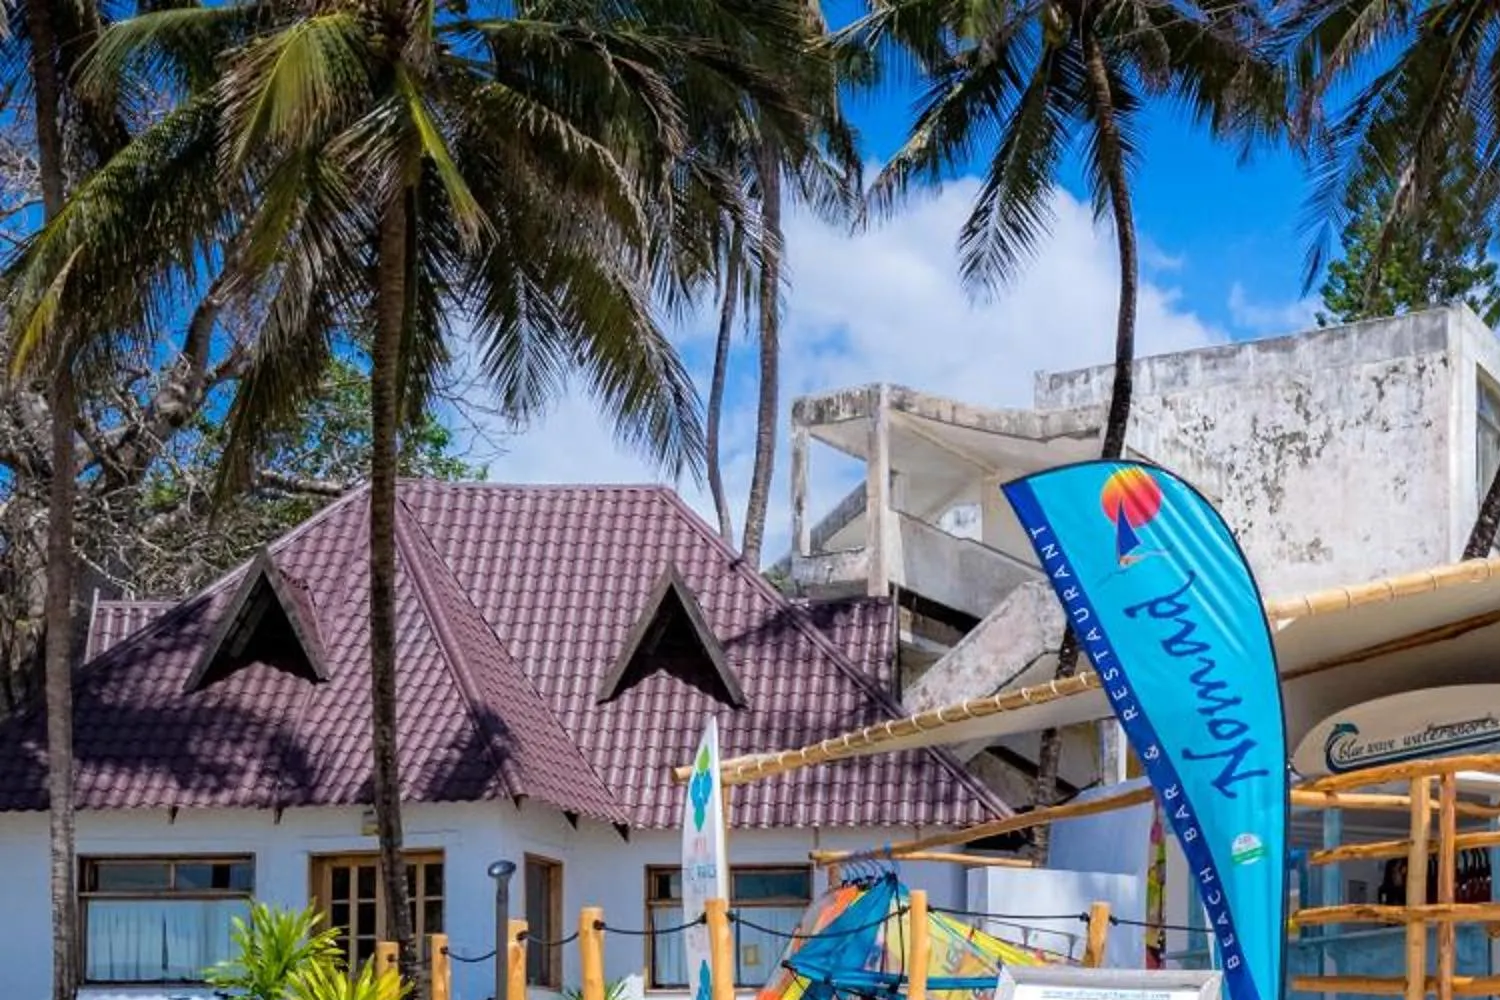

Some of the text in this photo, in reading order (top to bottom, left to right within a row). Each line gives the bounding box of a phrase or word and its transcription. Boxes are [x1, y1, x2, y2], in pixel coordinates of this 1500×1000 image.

[1029, 524, 1139, 722] RESTAURANT
[1122, 568, 1270, 799] Nomad
[1164, 783, 1198, 842] BAR
[1200, 866, 1241, 969] BEACH
